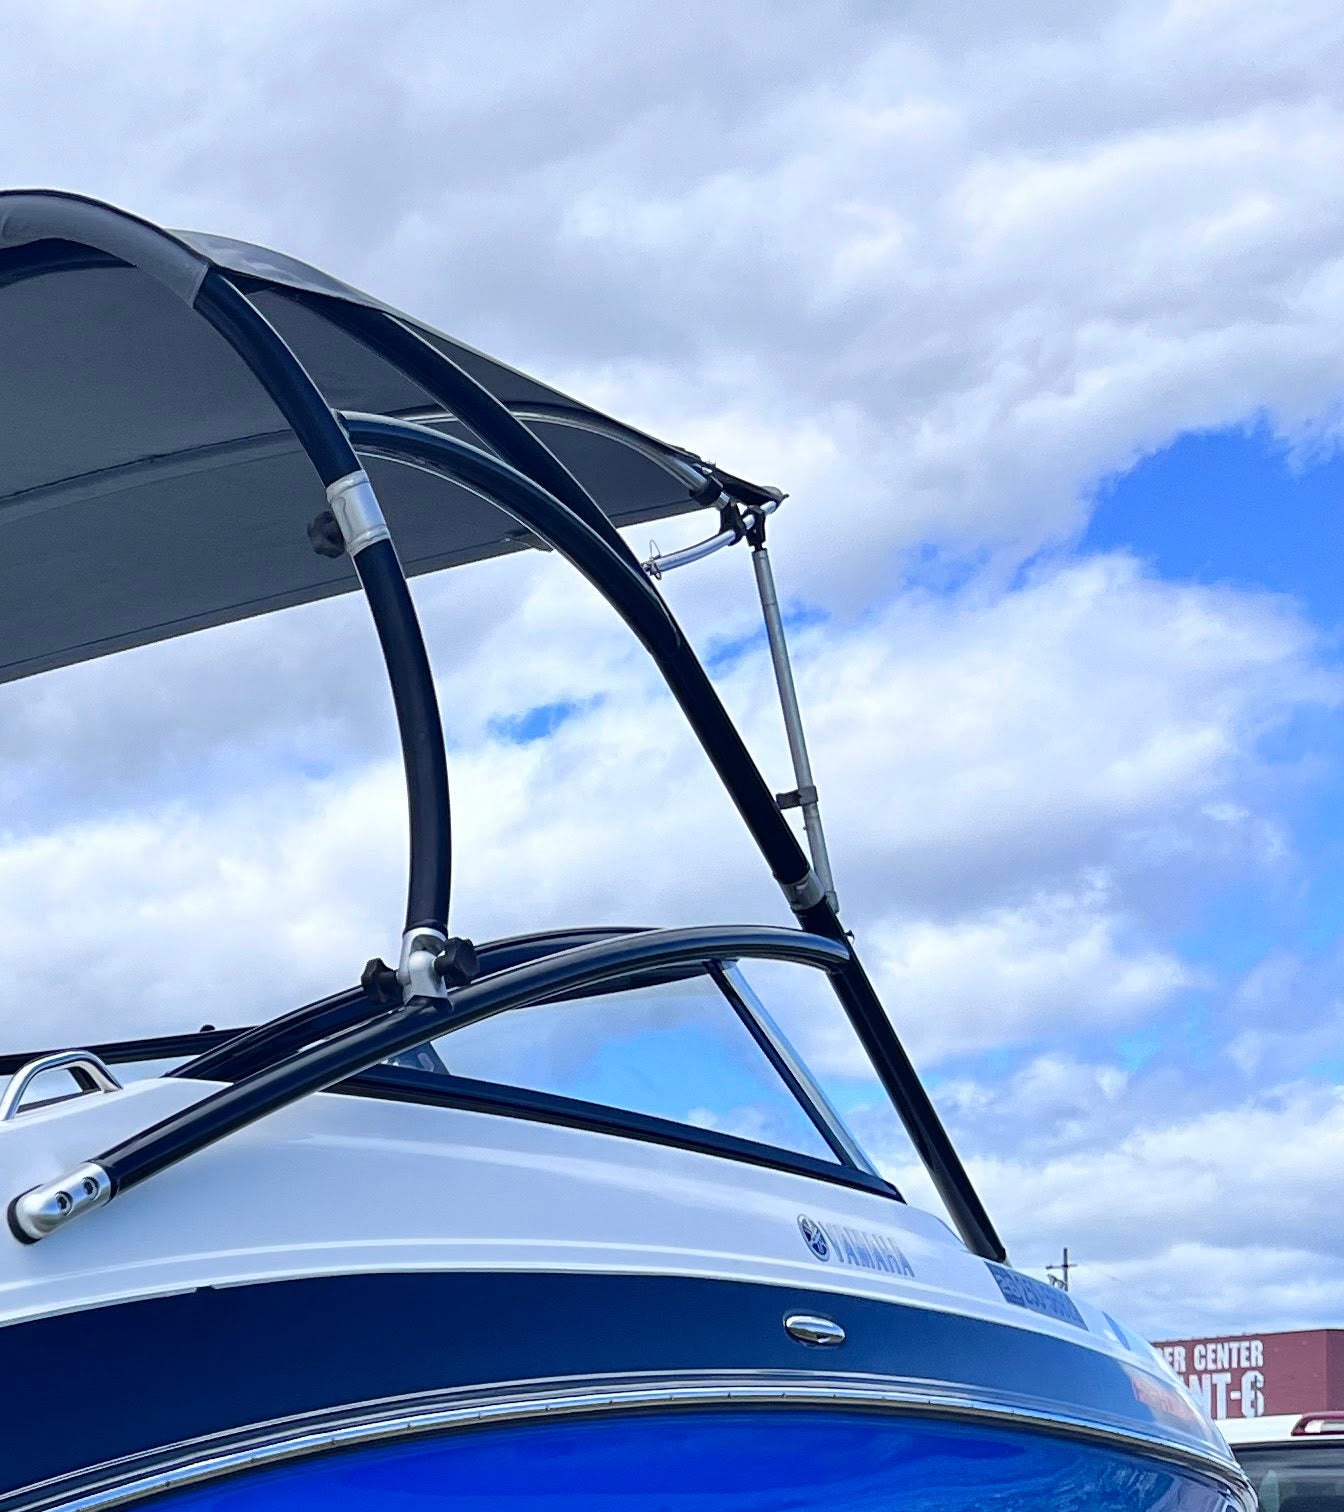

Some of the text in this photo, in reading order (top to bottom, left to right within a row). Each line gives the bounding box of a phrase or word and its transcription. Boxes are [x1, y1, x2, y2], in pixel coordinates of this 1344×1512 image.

[817, 1221, 915, 1277] YAMAHA
[1193, 1340, 1264, 1371] CENTER
[1179, 1370, 1264, 1420] NT-6
